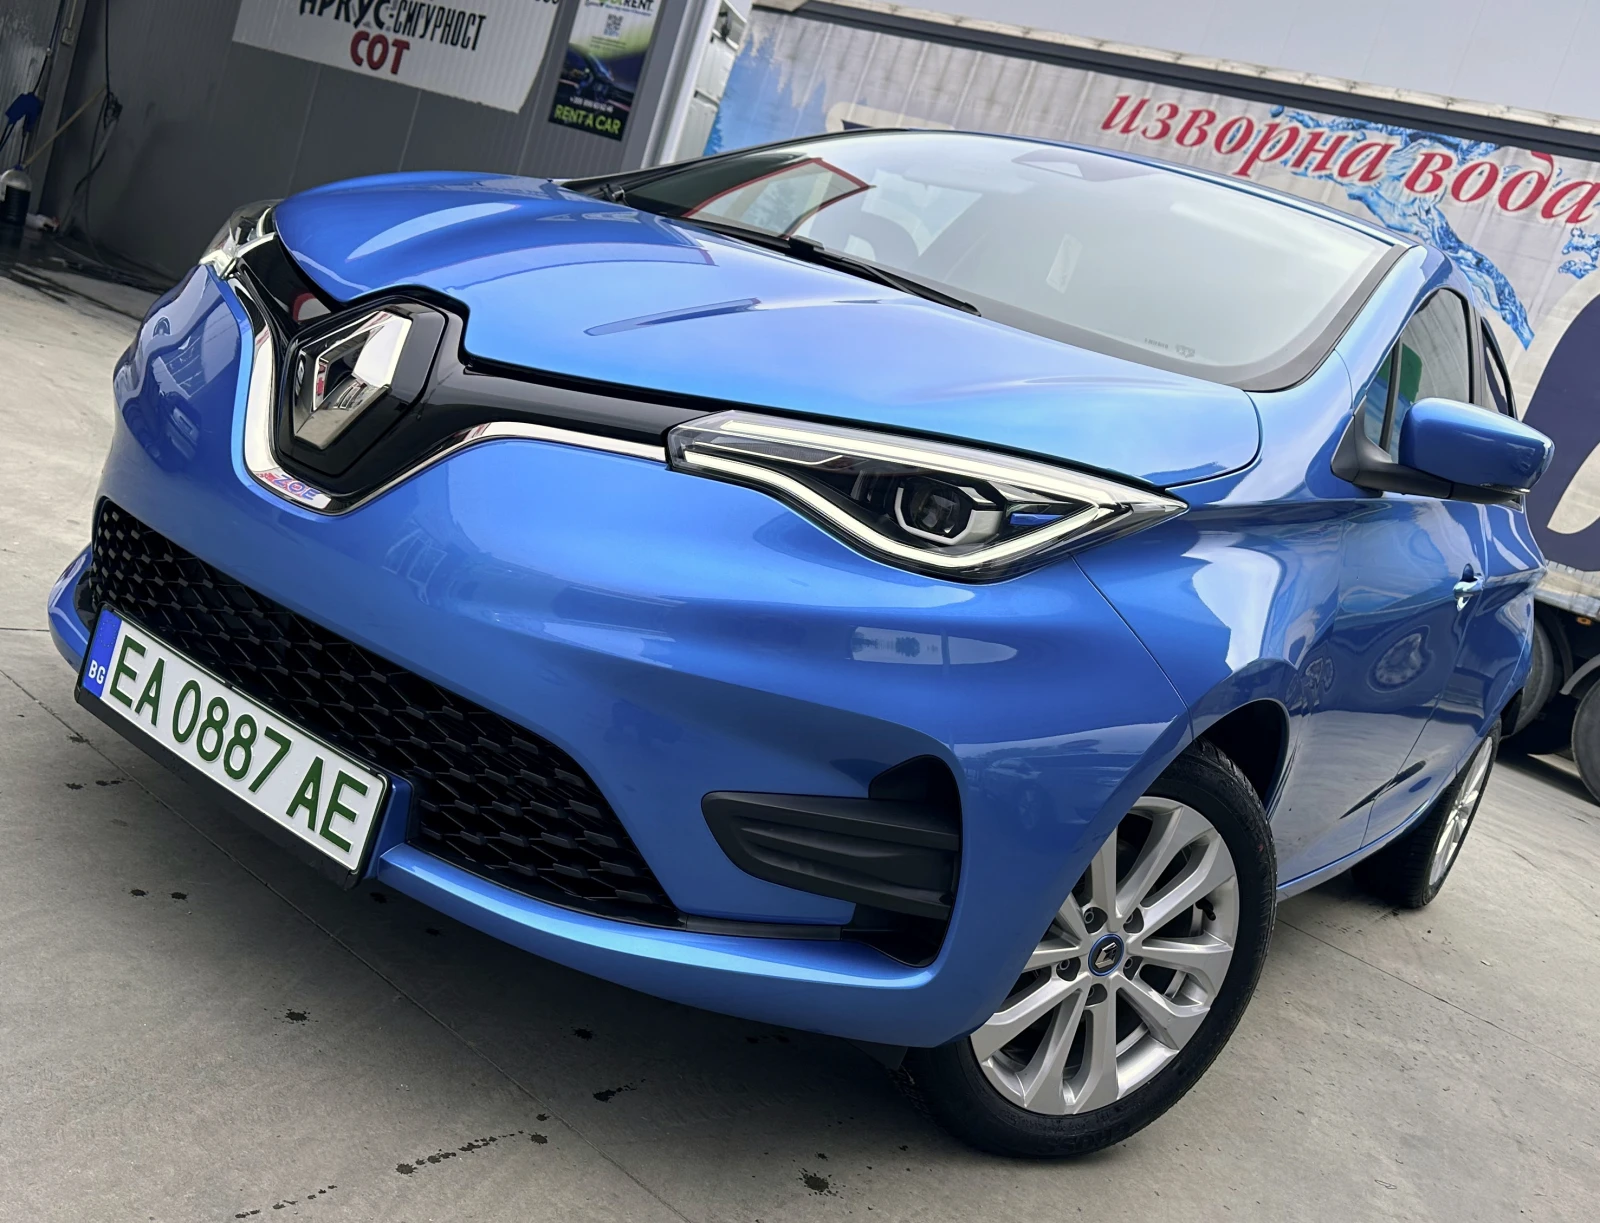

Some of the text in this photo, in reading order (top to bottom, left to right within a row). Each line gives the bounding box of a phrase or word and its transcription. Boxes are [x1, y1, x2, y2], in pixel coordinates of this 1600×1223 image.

[350, 30, 410, 75] СОТ
[554, 104, 587, 125] RENT
[584, 112, 594, 128] A
[595, 115, 621, 134] CAR
[1101, 95, 1600, 224] изворна вода
[273, 474, 322, 501] ZOE
[88, 659, 105, 685] BG
[109, 634, 369, 853] EA 0887 AE
